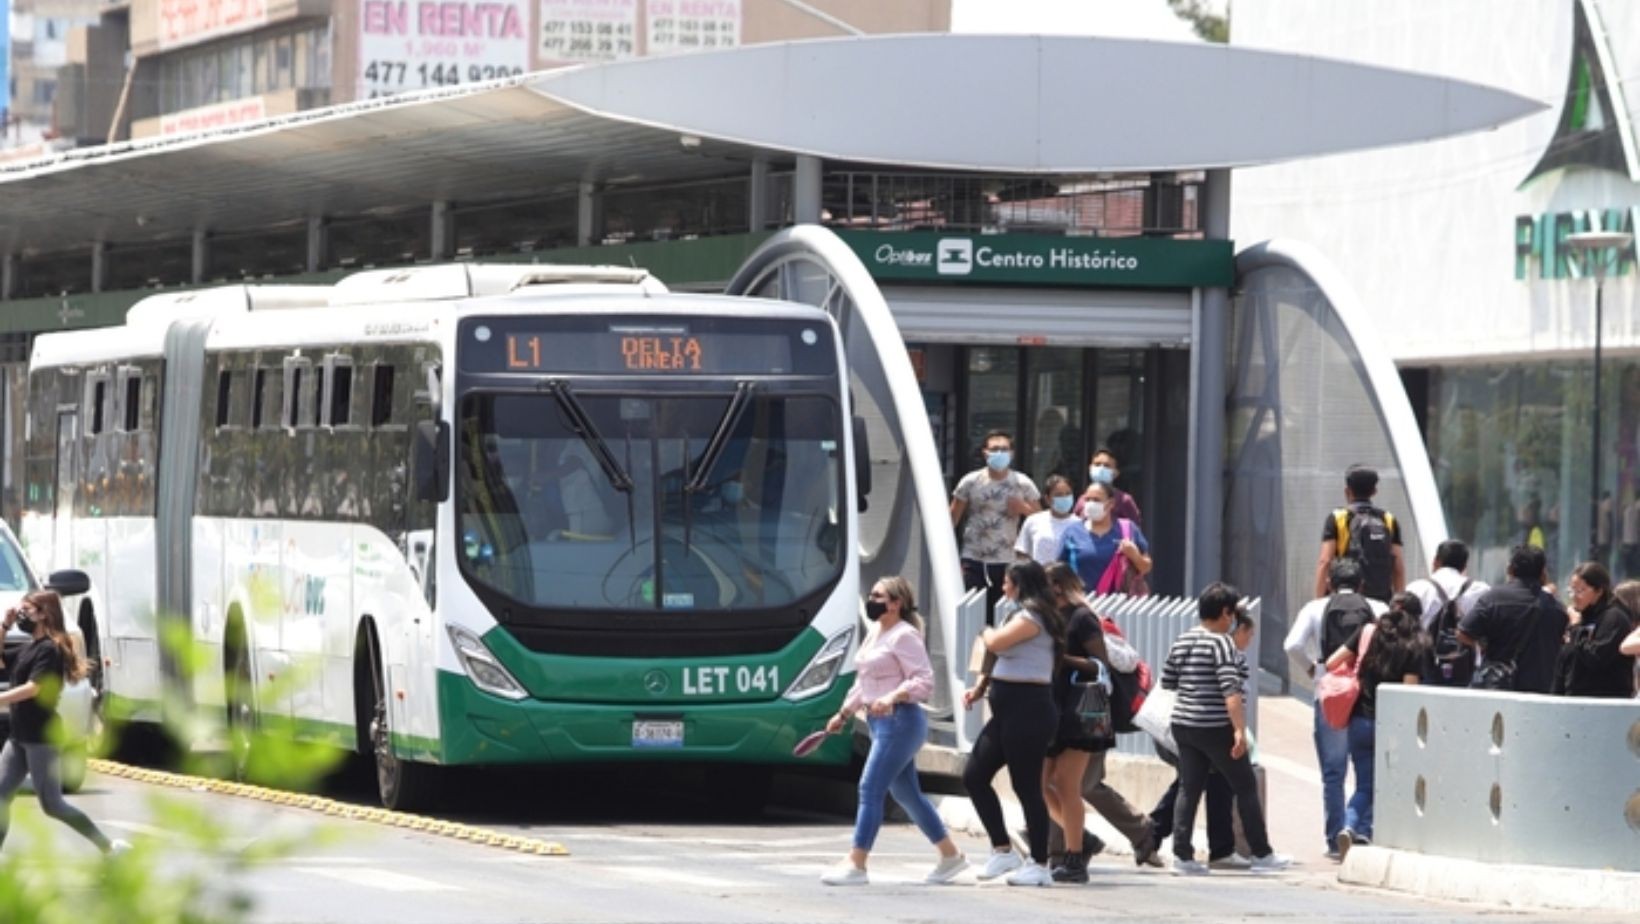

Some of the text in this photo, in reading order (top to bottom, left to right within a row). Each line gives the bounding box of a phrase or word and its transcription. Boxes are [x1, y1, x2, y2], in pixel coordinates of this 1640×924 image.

[364, 1, 525, 39] EN RENTA
[365, 60, 407, 85] 477
[418, 63, 460, 86] 144
[976, 247, 1043, 267] Centro
[1050, 248, 1138, 270] Histórico
[507, 336, 541, 367] L1
[622, 337, 702, 355] DELTA
[683, 665, 779, 695] LET 041
